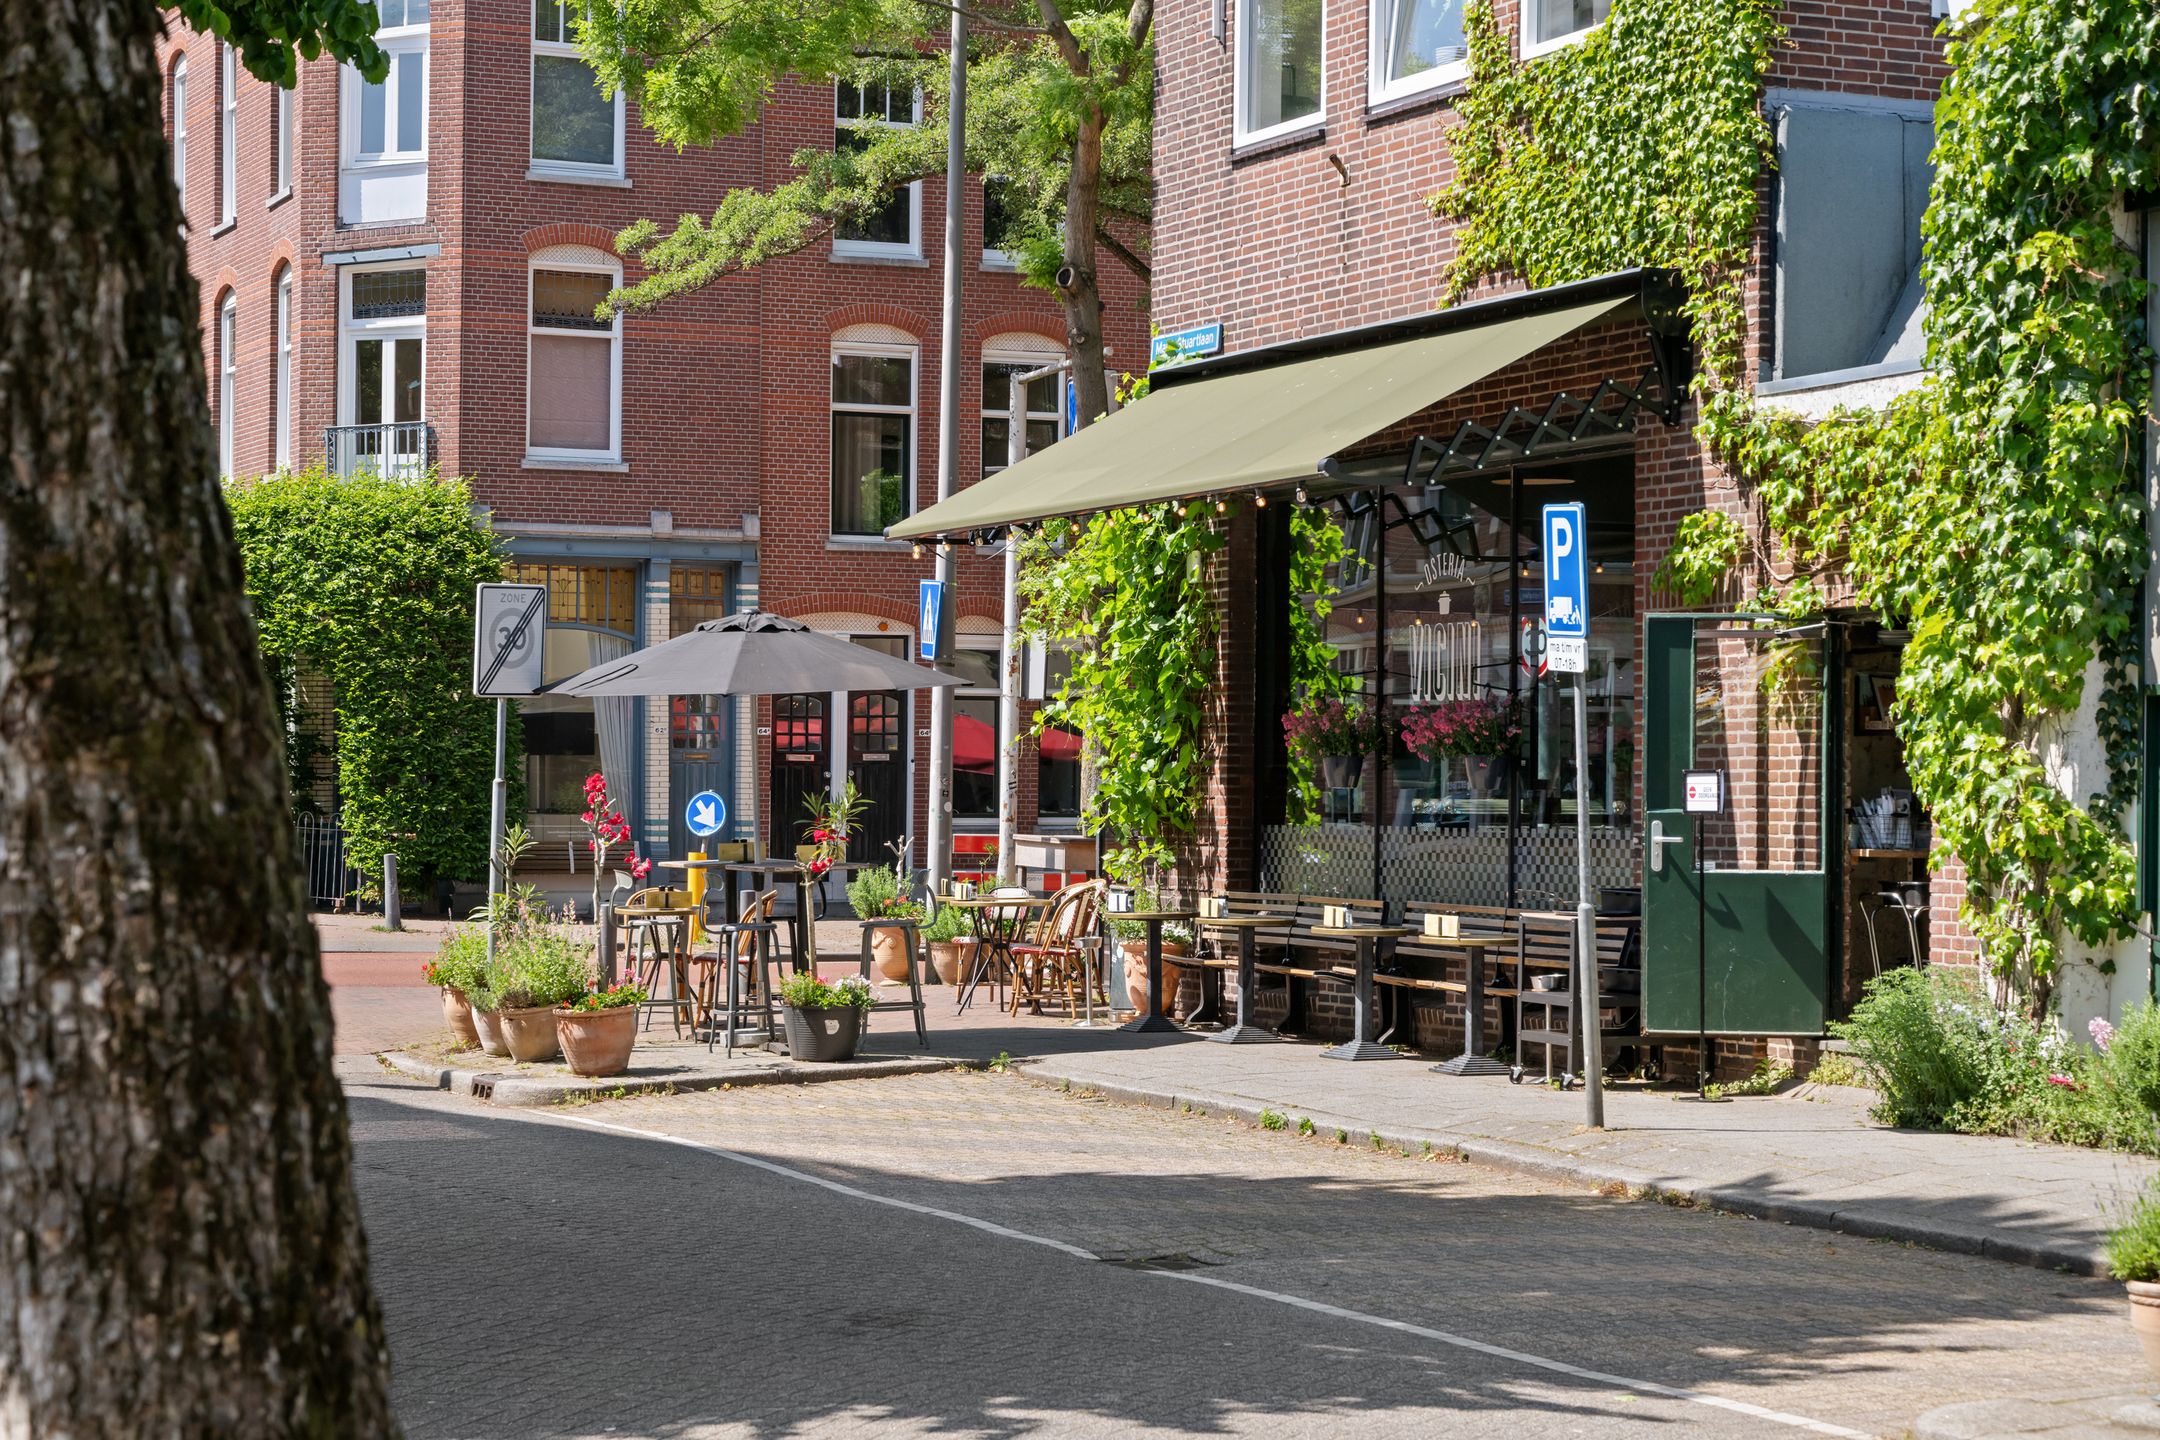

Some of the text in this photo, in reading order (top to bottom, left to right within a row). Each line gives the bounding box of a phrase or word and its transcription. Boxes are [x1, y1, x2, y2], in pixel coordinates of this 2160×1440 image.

[1177, 333, 1214, 350] Stuartlaan
[1551, 517, 1572, 581] P
[1424, 553, 1466, 585] OSTERIA
[500, 593, 527, 604] ZONE
[497, 626, 527, 650] 30
[1408, 621, 1481, 702] VICINI
